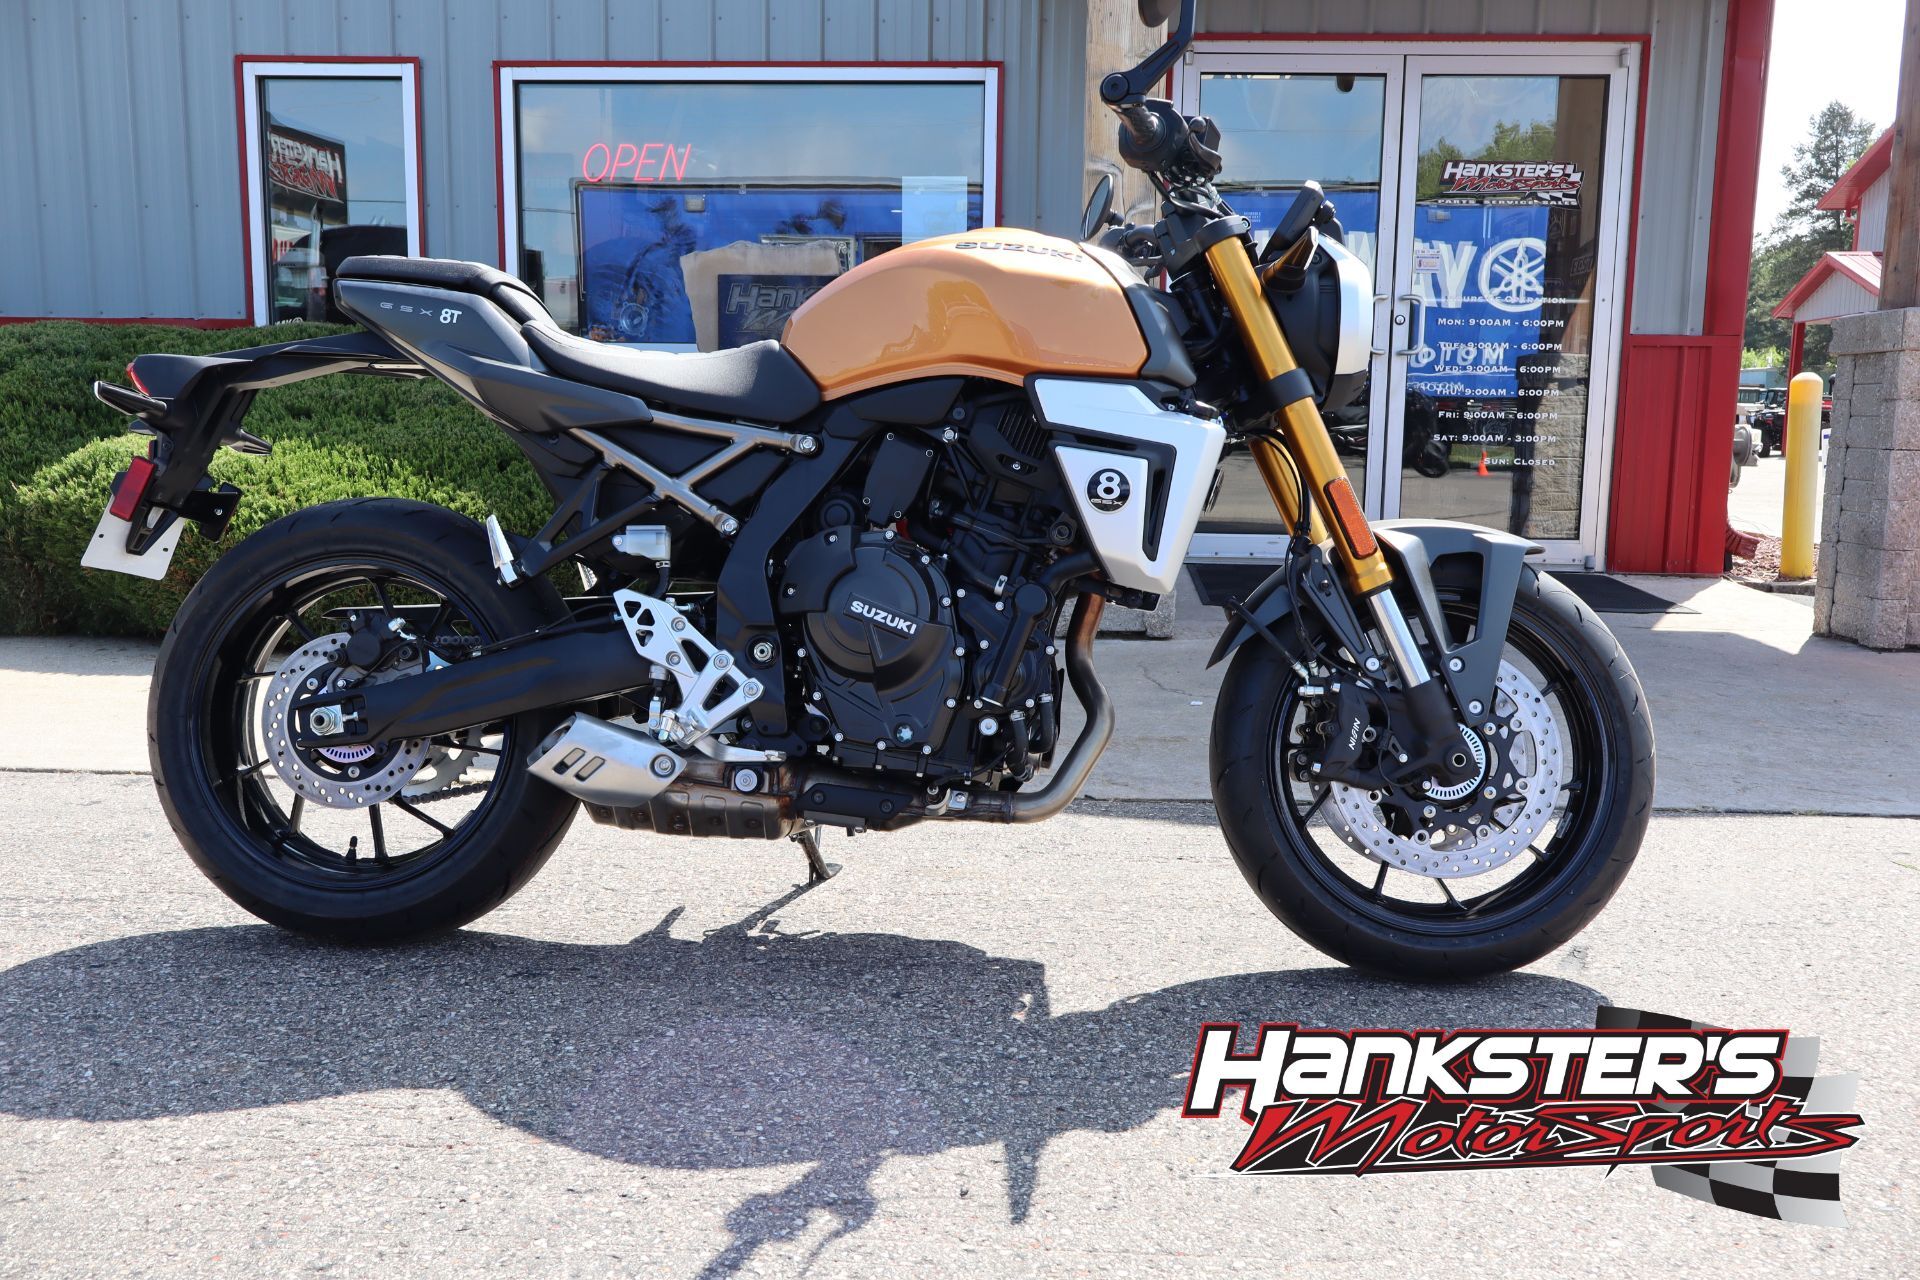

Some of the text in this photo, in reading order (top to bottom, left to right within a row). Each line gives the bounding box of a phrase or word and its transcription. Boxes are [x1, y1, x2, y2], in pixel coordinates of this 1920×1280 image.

[582, 143, 692, 182] OPEN
[955, 241, 1083, 263] SUZUKI
[440, 308, 462, 324] 8T
[1469, 318, 1511, 327] 9:00AM
[1522, 319, 1564, 328] 6:00PM
[1467, 342, 1509, 350] 9:00AM
[1521, 343, 1562, 351] 6:00PM
[1466, 365, 1508, 373] 9:00AM
[1465, 388, 1506, 396] 9:00AM
[1463, 411, 1505, 419] 9:00AM
[1462, 434, 1504, 442] 9:00AM
[1097, 471, 1121, 500] 8
[850, 600, 917, 635] SUZUKI
